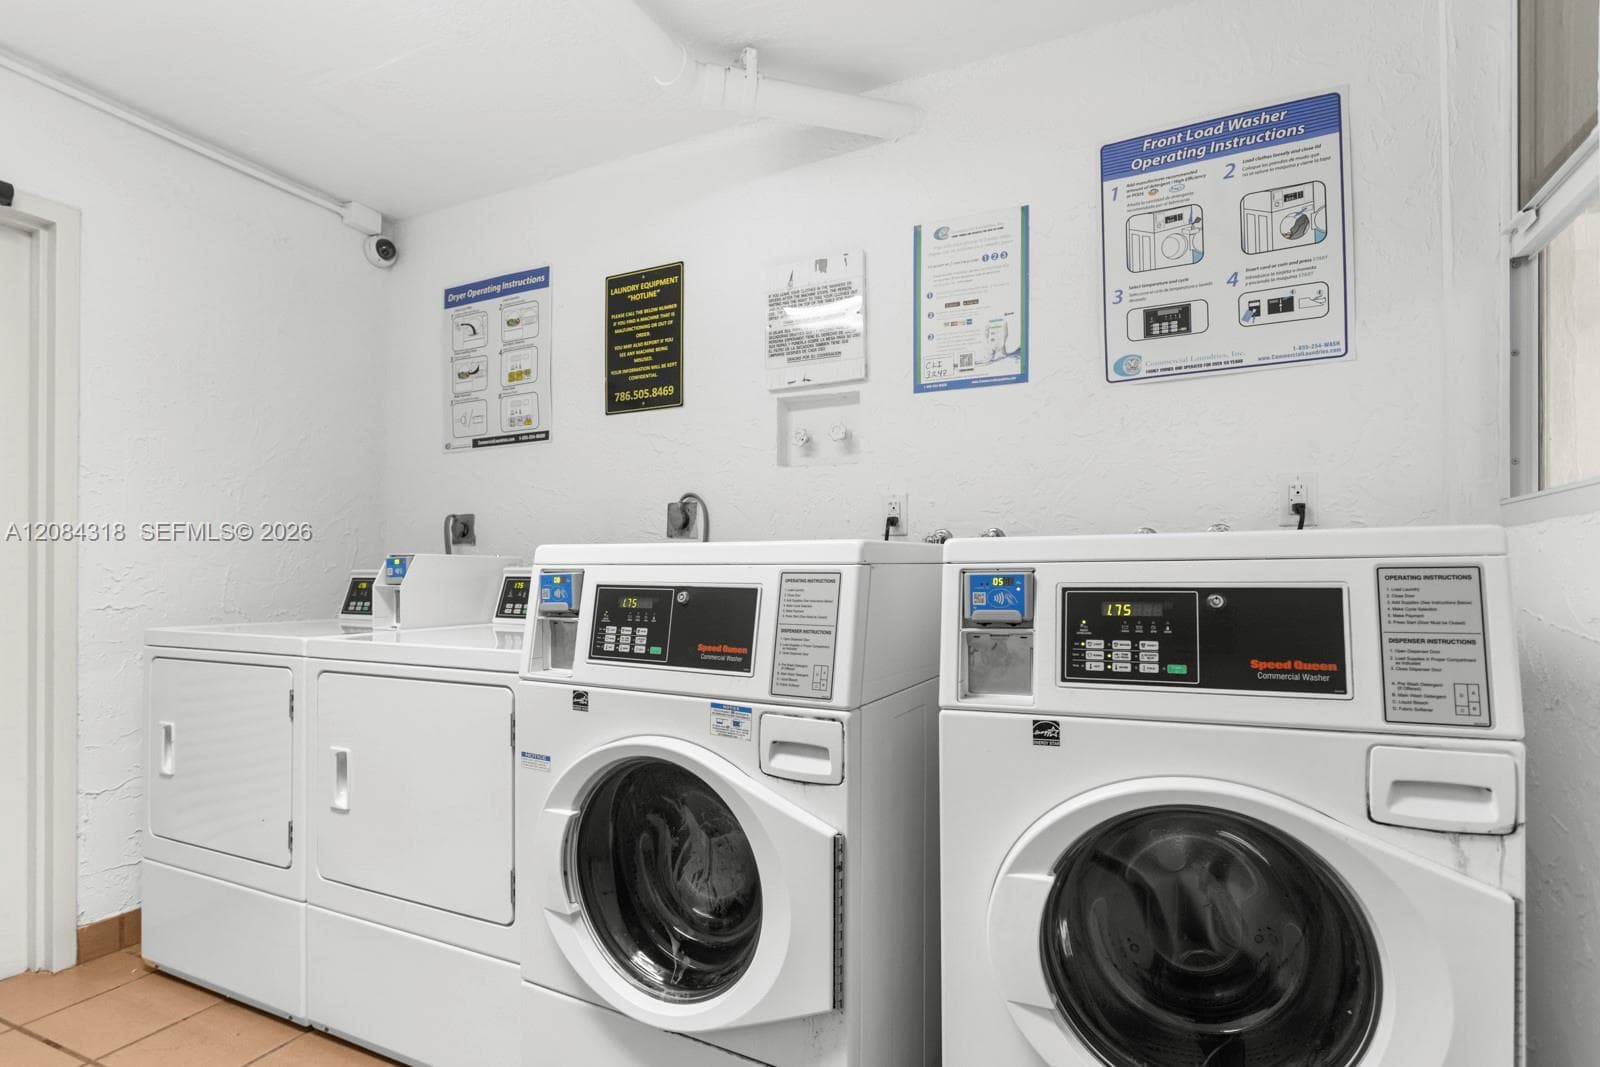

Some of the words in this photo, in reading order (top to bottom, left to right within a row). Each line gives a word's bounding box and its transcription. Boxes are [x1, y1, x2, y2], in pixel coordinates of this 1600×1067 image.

[1142, 133, 1183, 152] Front
[1186, 122, 1224, 142] Load
[1228, 109, 1287, 132] Washer
[1130, 146, 1206, 170] Operating
[1210, 124, 1305, 152] Instructions
[1222, 163, 1236, 180] 2
[1112, 186, 1118, 202] 1
[610, 284, 639, 295] LAUNDRY
[641, 276, 679, 289] EQUIPMENT
[1226, 272, 1239, 287] 4
[448, 292, 466, 302] Dryer
[467, 284, 501, 298] Operating
[502, 275, 545, 290] Instructions
[1112, 290, 1123, 304] 3
[614, 385, 674, 402] 786.505.8469
[698, 644, 721, 652] Speed
[723, 645, 747, 654] Queen
[1250, 659, 1291, 671] Speed
[1294, 660, 1337, 671] Queen
[1258, 672, 1300, 681] Commercial
[1302, 673, 1330, 682] Washer
